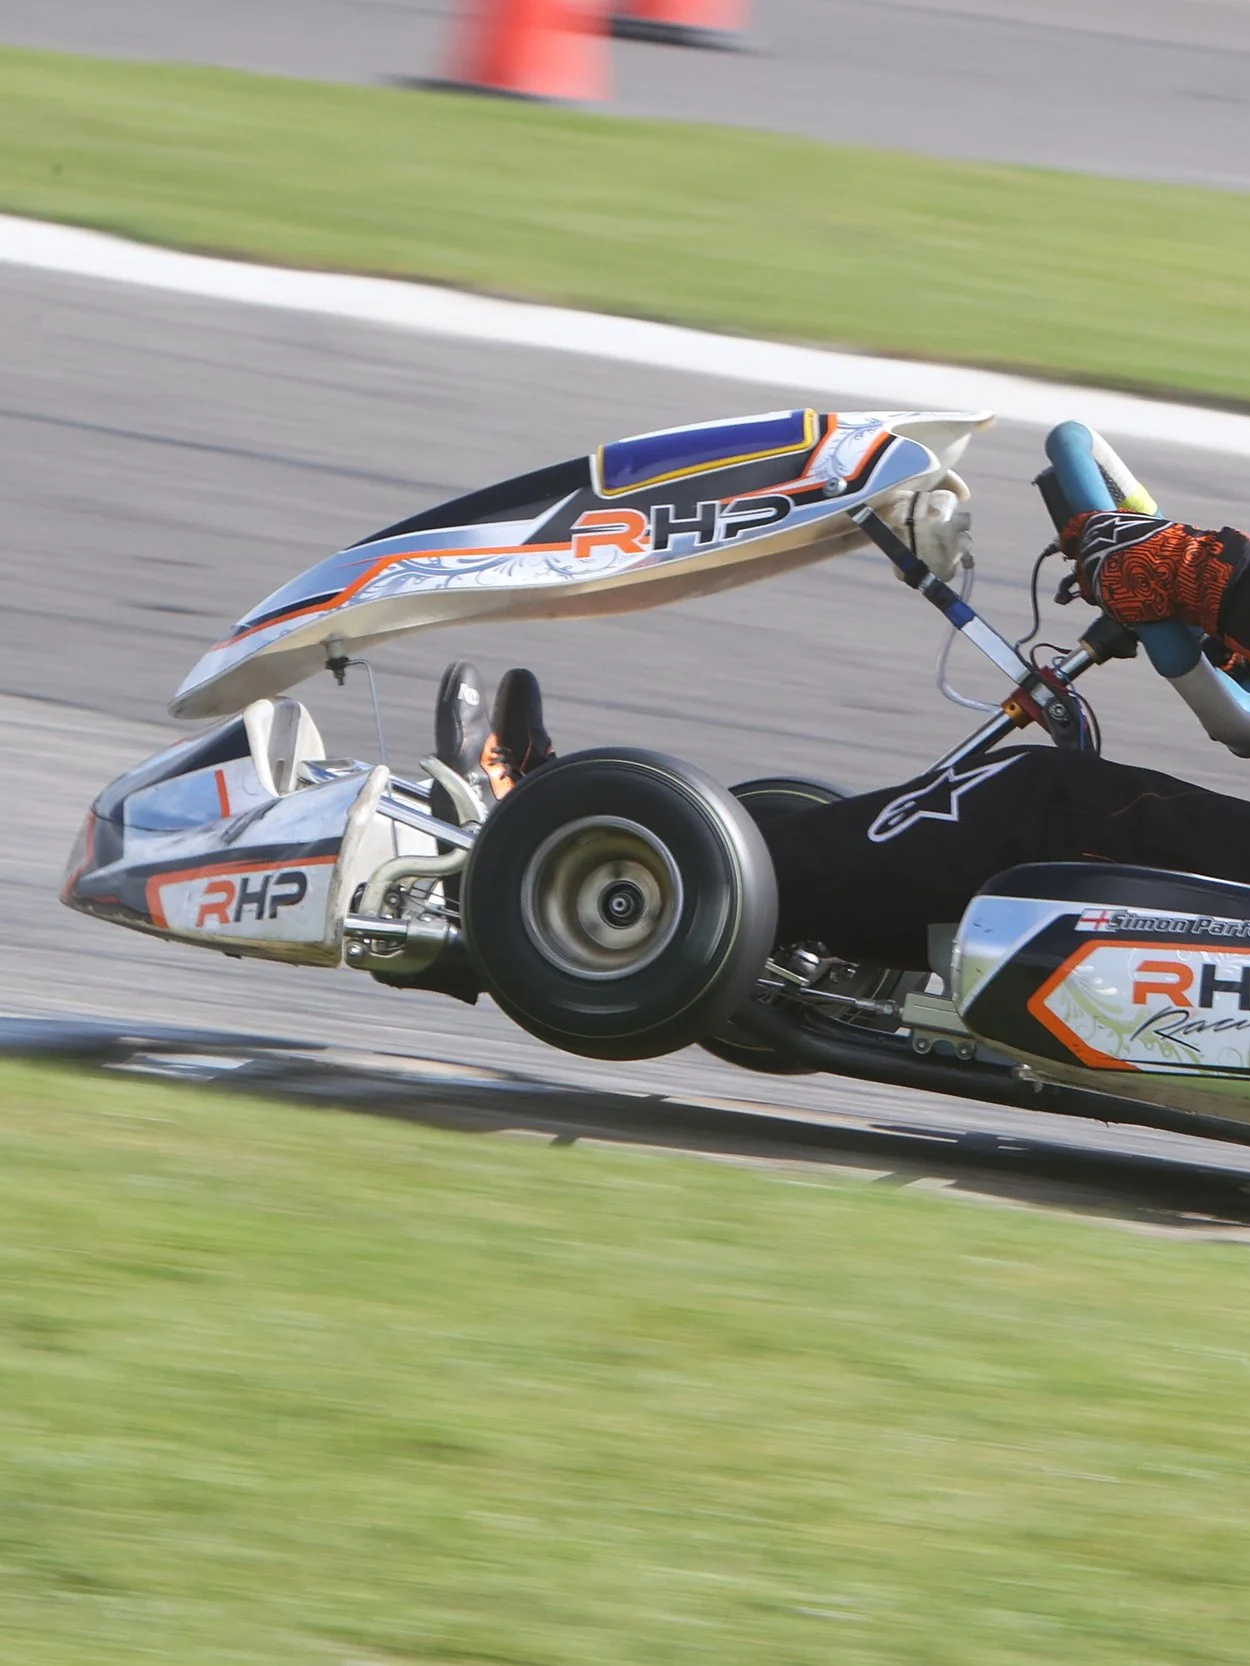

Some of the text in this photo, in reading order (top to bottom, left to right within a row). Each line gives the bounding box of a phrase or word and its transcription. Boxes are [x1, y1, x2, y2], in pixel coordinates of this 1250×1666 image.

[571, 495, 795, 558] RHP
[196, 871, 308, 928] RHP
[1107, 909, 1190, 933] Simon
